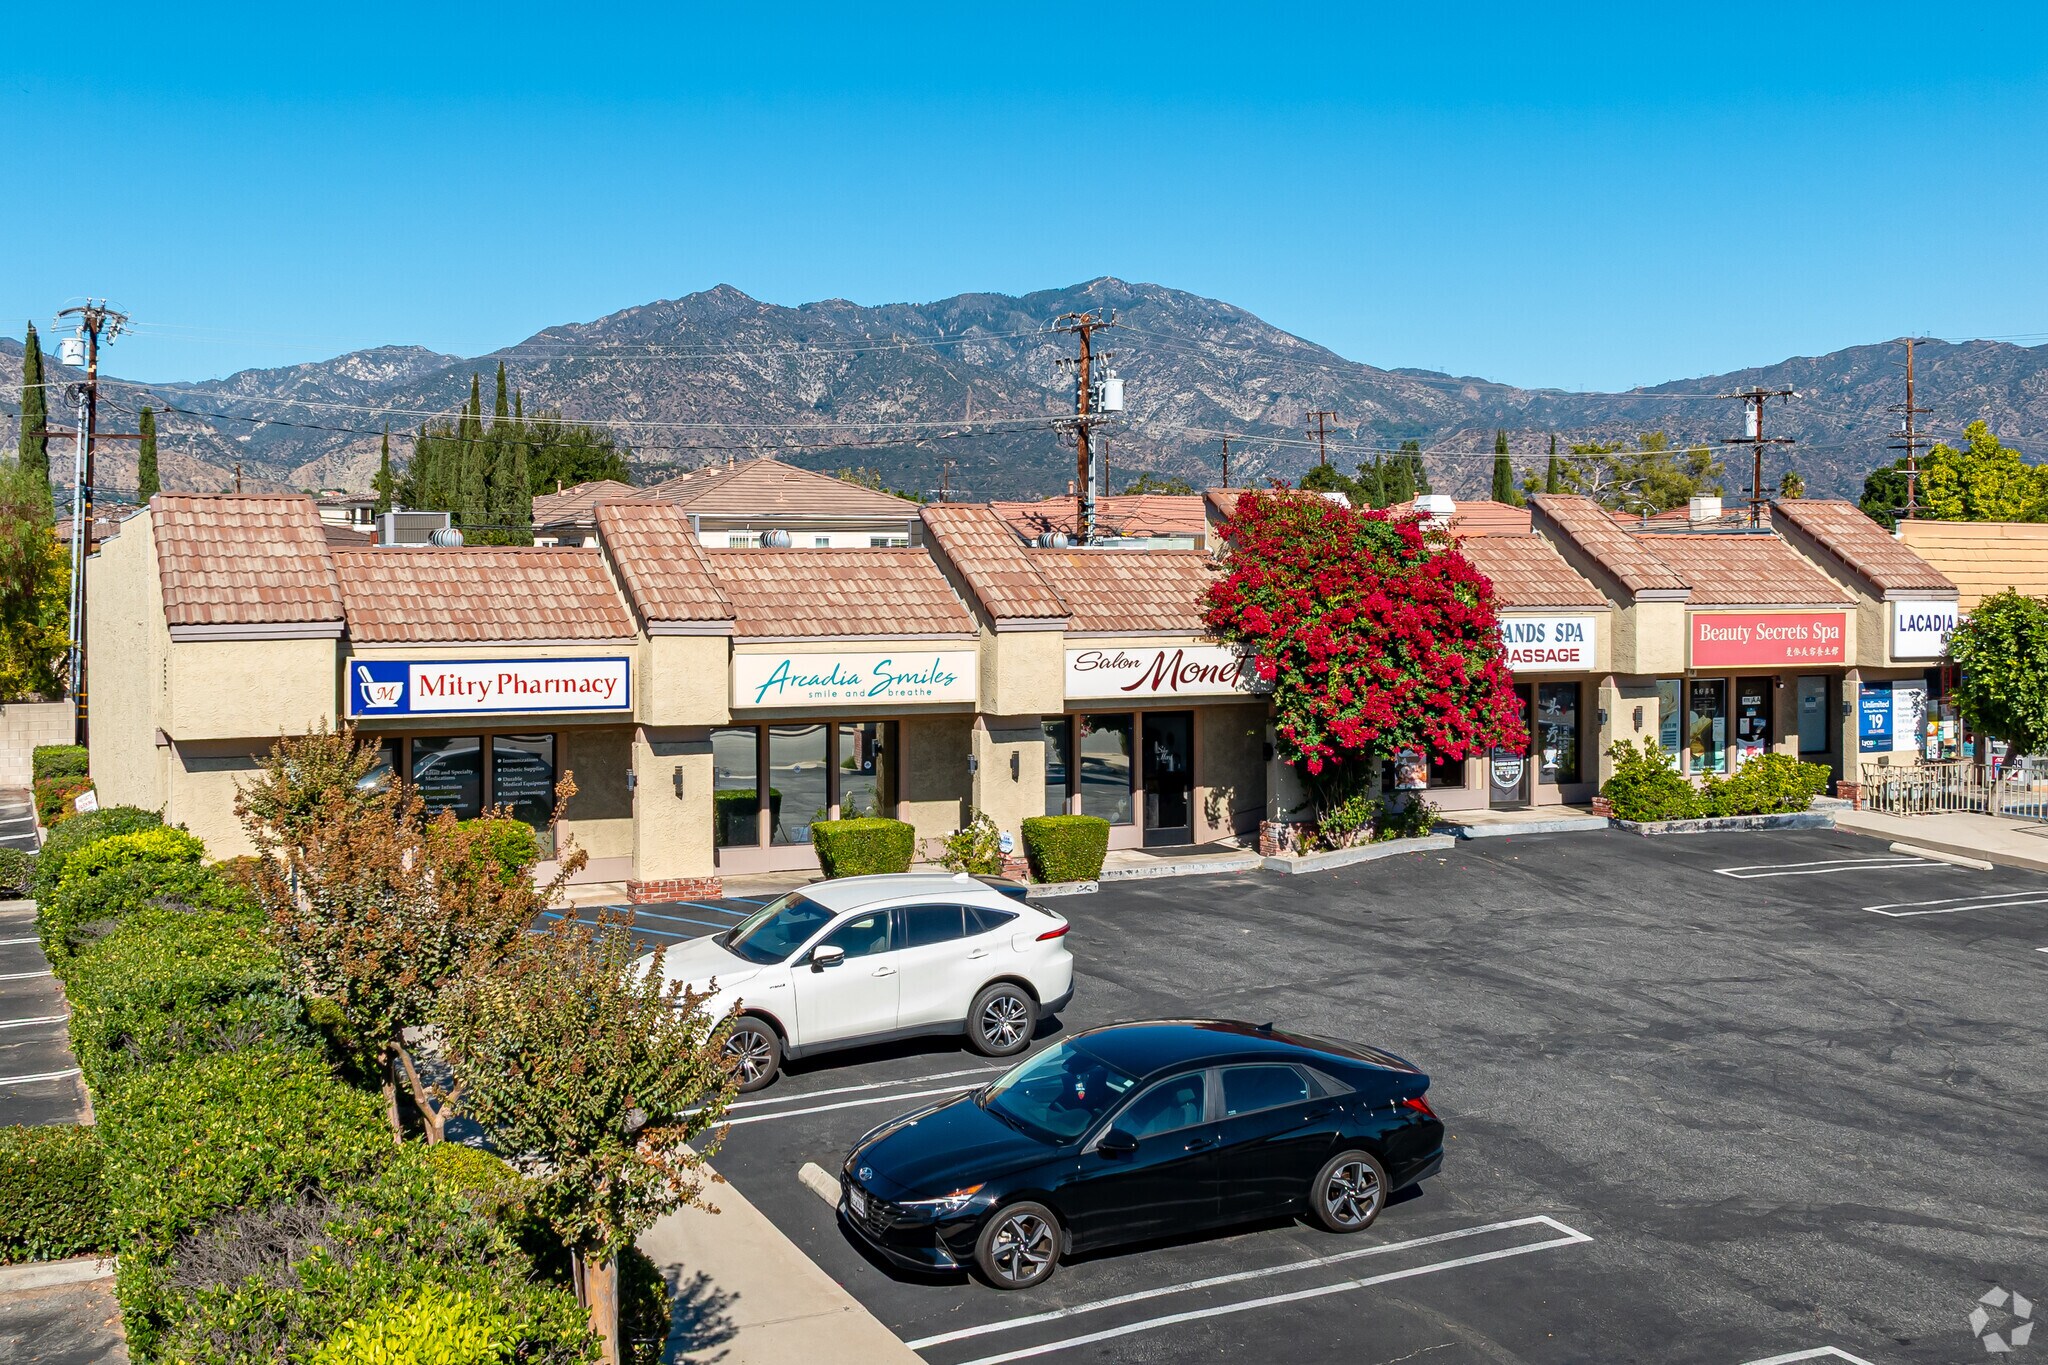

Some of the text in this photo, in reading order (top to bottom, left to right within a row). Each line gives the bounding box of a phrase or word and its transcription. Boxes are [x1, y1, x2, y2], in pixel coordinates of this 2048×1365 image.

[1501, 623, 1584, 643] ANDS SPA
[1700, 622, 1840, 645] Beauty Secrets Spa
[1900, 614, 1954, 632] LACADIA
[755, 657, 958, 704] Arcadia Smiles
[1074, 648, 1256, 692] Salon Monet
[377, 685, 397, 701] M
[419, 673, 618, 703] Mitry Pharmacy
[808, 688, 932, 699] smile and breathe
